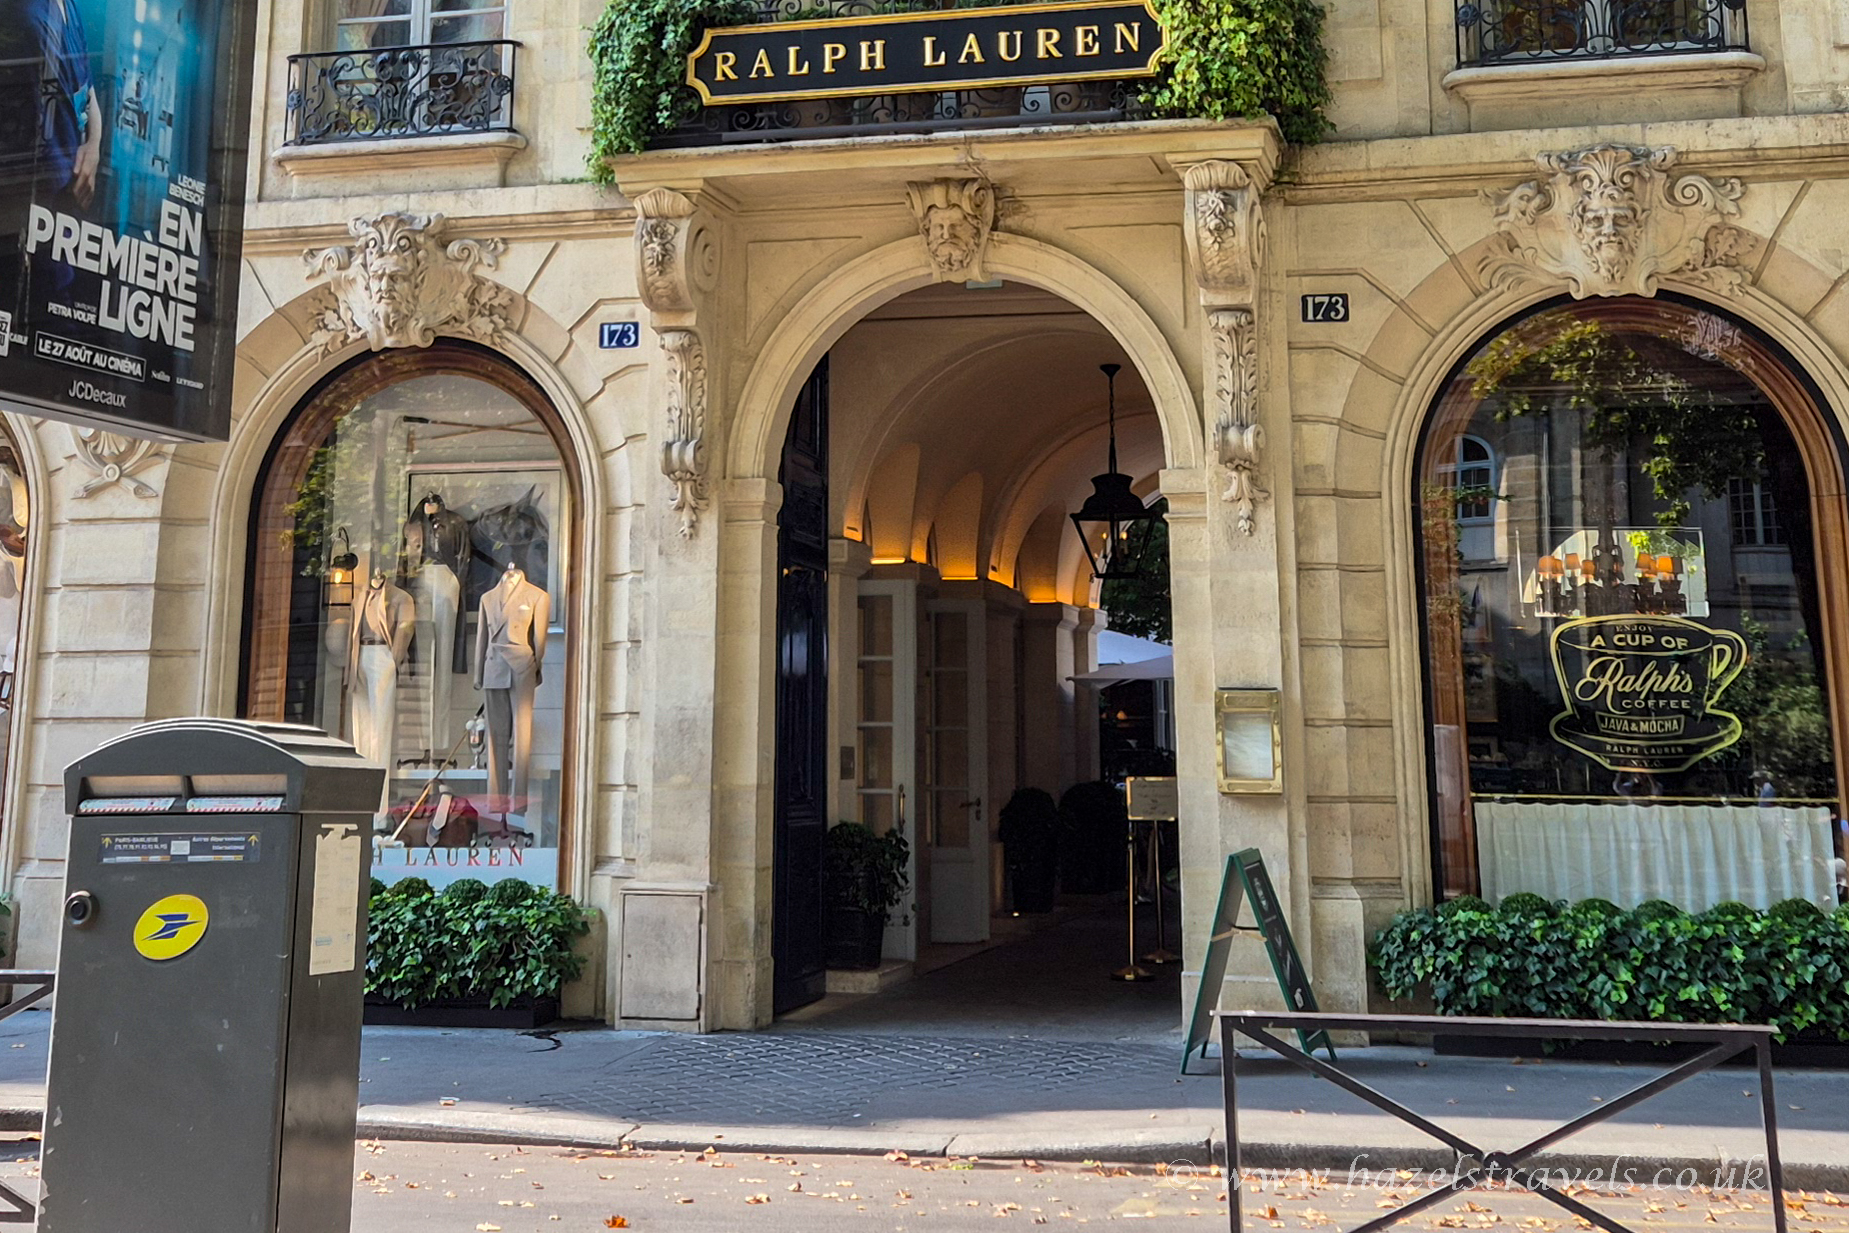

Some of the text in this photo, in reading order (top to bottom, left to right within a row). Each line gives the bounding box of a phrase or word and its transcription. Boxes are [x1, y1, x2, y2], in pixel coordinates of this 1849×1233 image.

[714, 21, 1141, 82] RALPH LAUREN
[169, 183, 205, 208] BENESCH
[178, 173, 206, 196] LEONIE
[159, 198, 203, 257] EN
[26, 203, 200, 304] PREMIÈRE
[47, 301, 73, 319] PETRA
[73, 308, 97, 325] VOLPE
[98, 279, 197, 353] LIGNE
[1306, 295, 1346, 321] 173
[602, 323, 637, 347] 173
[38, 338, 51, 354] LE
[51, 342, 65, 356] 27
[64, 345, 93, 365] AOÛT
[92, 352, 107, 368] AU
[108, 355, 143, 378] CINÉMA
[68, 379, 127, 409] JCDecaux
[1615, 624, 1654, 633] ENJOY
[1590, 633, 1689, 650] A CUP OF
[1575, 656, 1694, 715] Ralph's
[1621, 699, 1691, 709] COFFEE
[1605, 744, 1684, 755] RALPH LAUREN
[406, 847, 525, 867] LAUREN
